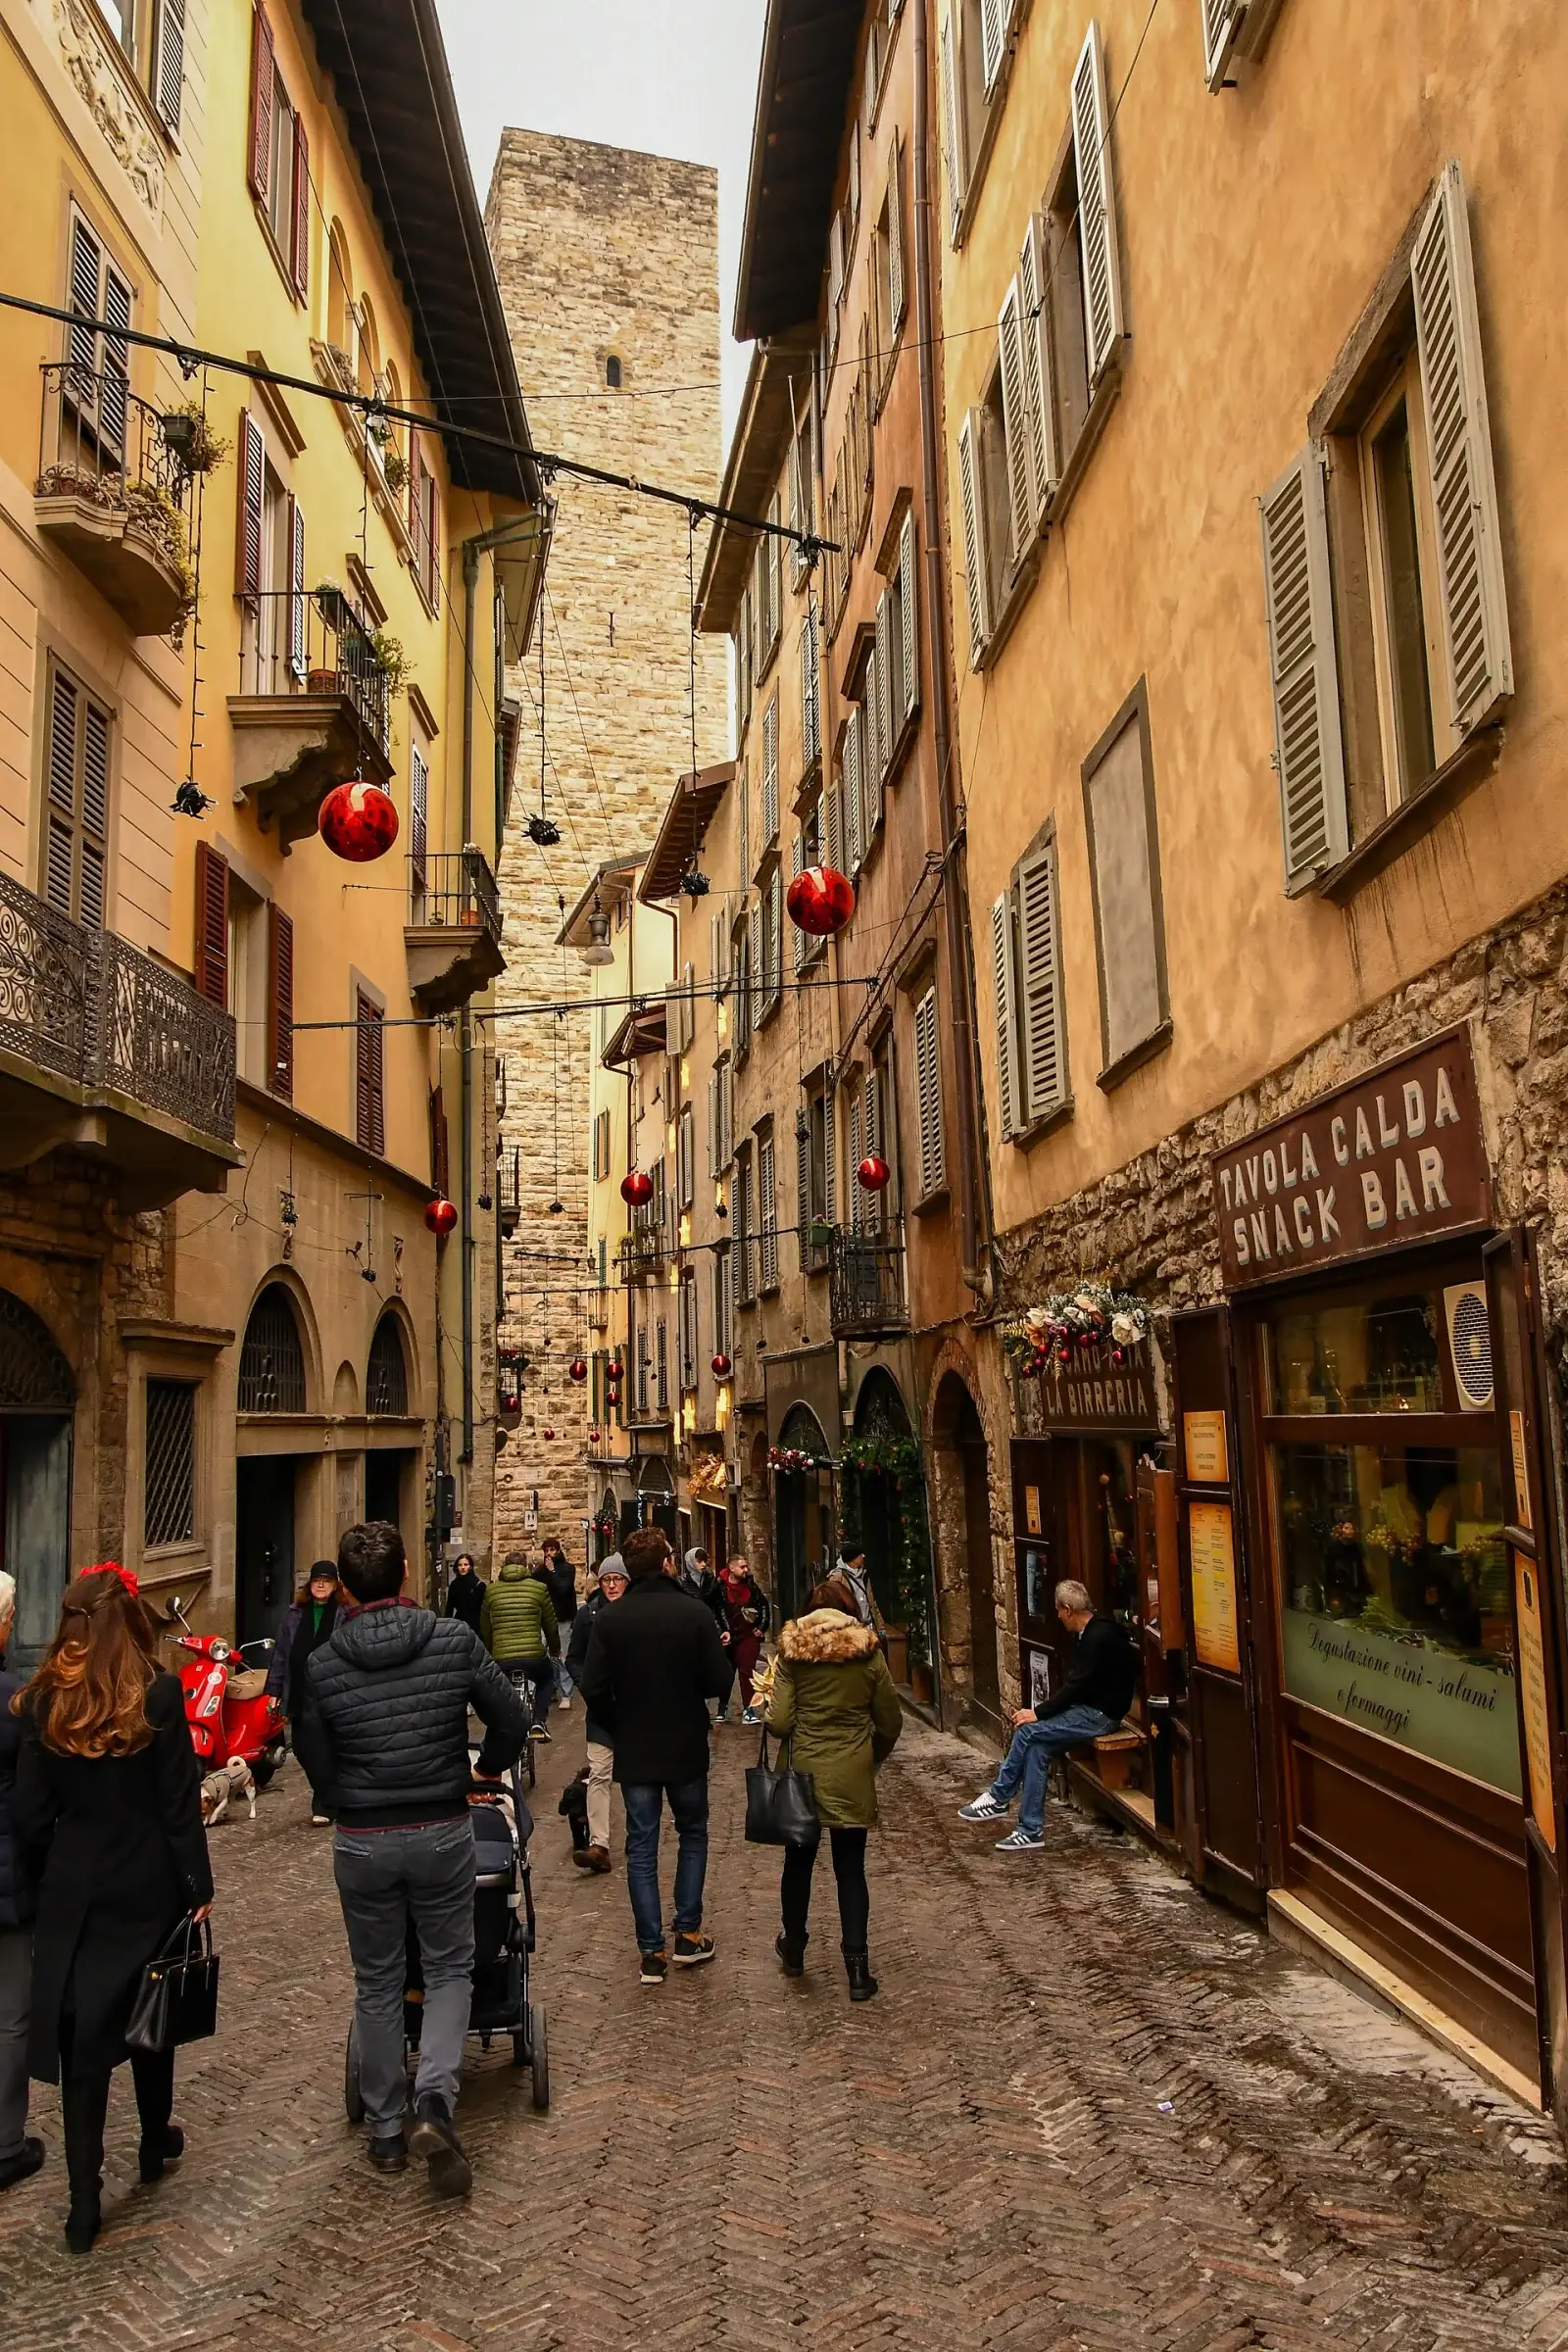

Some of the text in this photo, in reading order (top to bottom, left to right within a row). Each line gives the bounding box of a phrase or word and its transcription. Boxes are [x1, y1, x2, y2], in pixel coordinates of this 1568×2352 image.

[1220, 1067, 1460, 1210] TAVOLA CALDA
[1234, 1147, 1451, 1265] SNACK BAR
[1046, 1378, 1149, 1417] LA BIRRERIA
[1307, 1622, 1390, 1676] Degustazione
[1394, 1660, 1422, 1687] vini
[1438, 1670, 1497, 1712] salumi
[1345, 1680, 1411, 1735] formaggi
